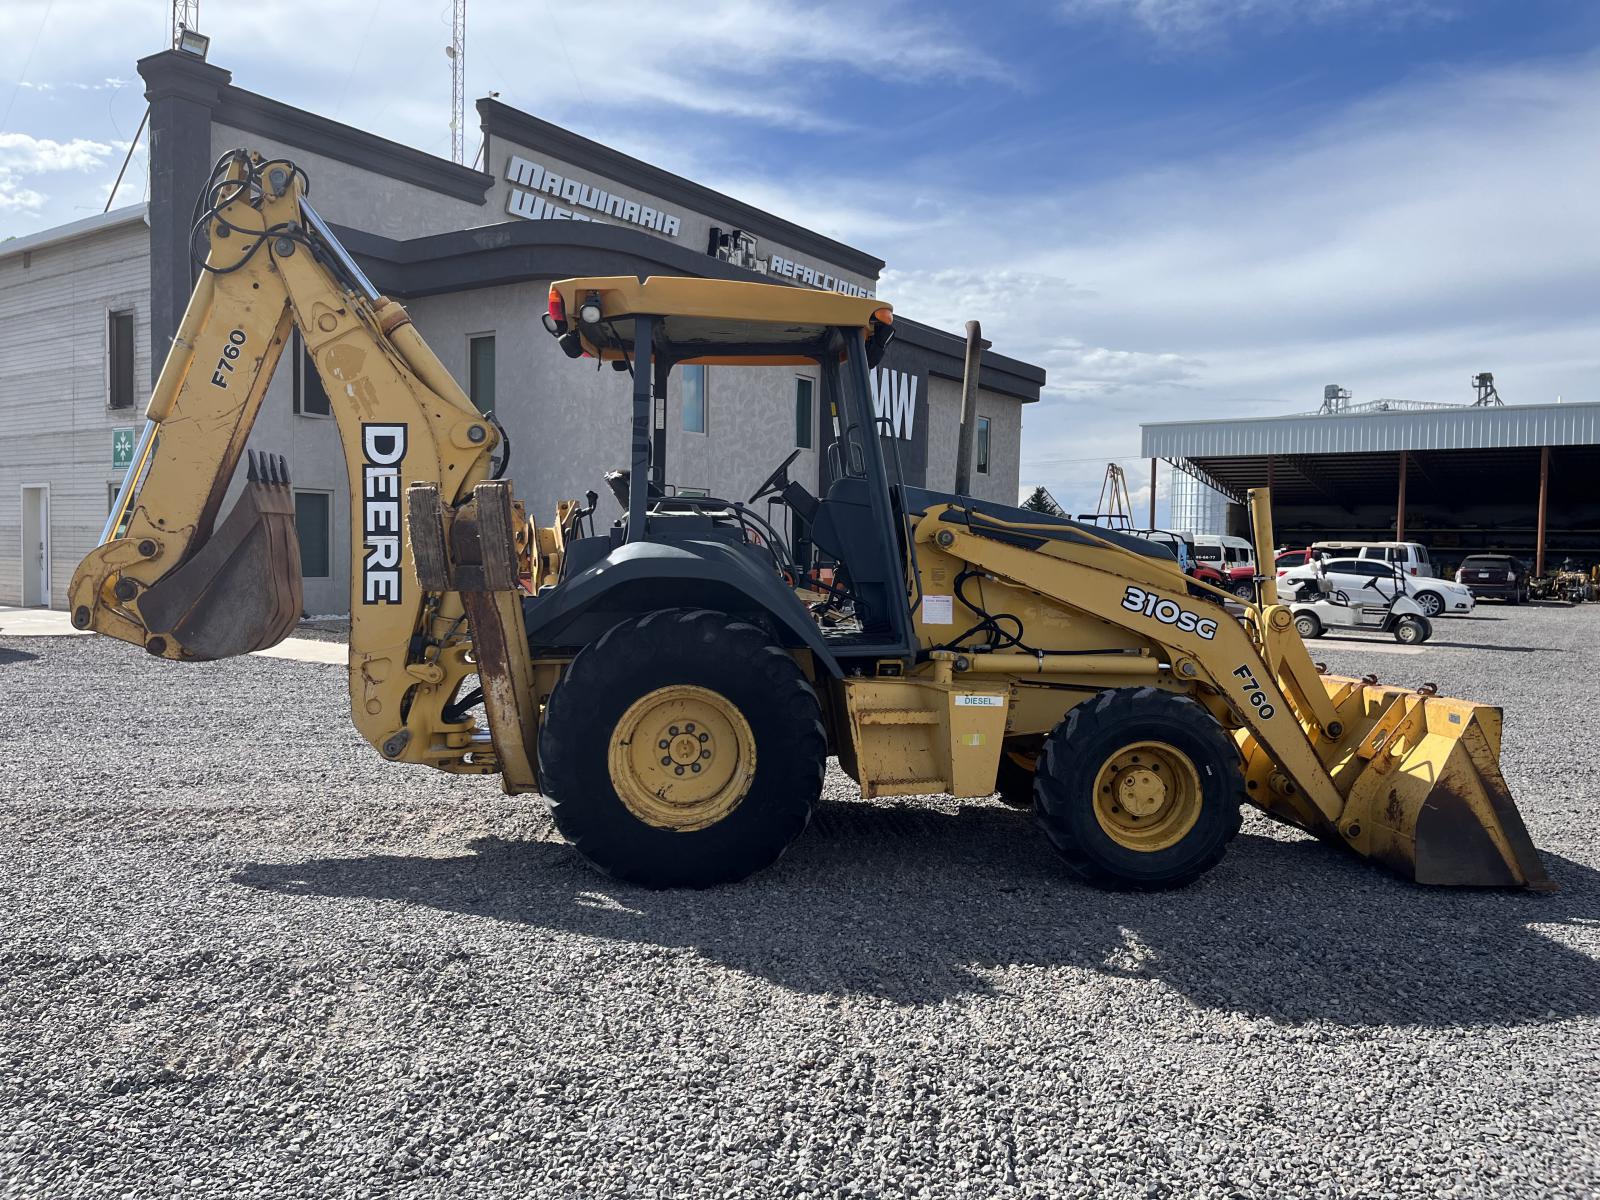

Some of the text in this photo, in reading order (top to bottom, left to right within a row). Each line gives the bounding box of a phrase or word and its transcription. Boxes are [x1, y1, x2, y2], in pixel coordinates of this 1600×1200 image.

[507, 155, 680, 237] MAQUINARIA
[211, 329, 246, 389] F760
[362, 424, 407, 604] DEERE
[1121, 586, 1218, 640] 310SG
[964, 697, 993, 705] DIESEL
[1232, 664, 1275, 720] F760
